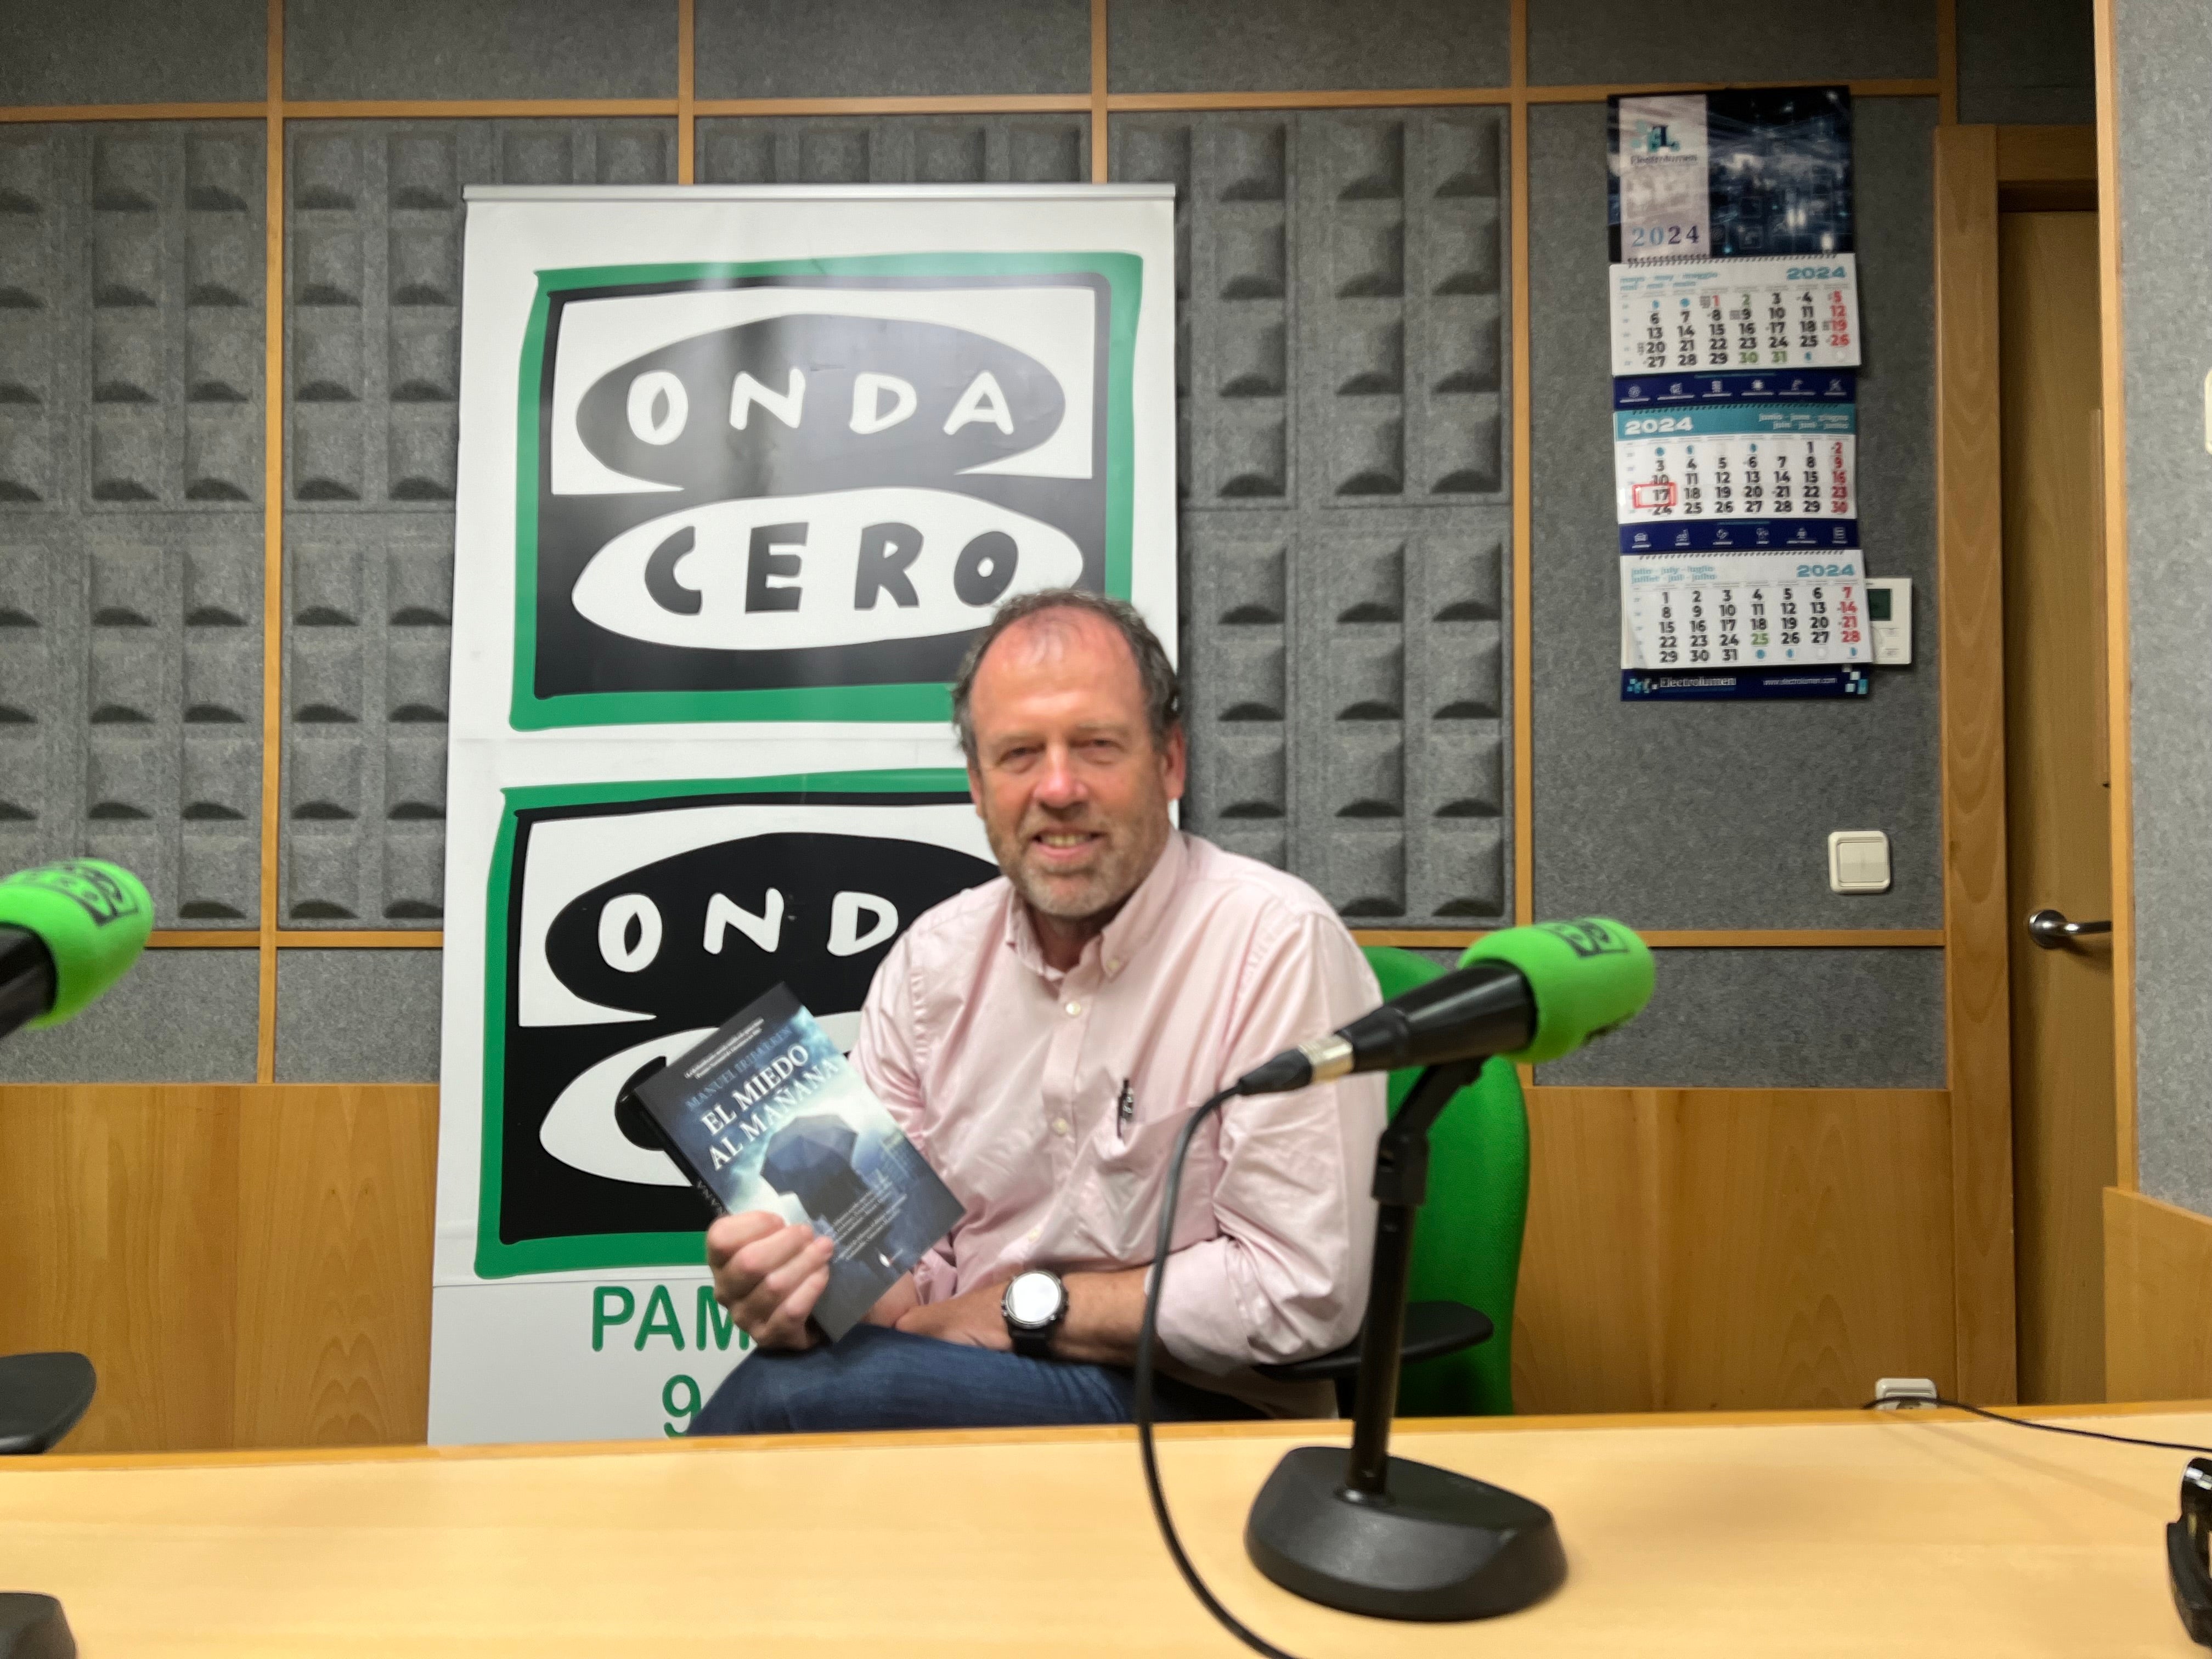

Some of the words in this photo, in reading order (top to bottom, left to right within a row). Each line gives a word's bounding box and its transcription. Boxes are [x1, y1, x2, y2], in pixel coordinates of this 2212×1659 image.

[1633, 225, 1699, 247] 2024
[1787, 267, 1846, 280] 2024
[1713, 295, 1720, 307] 1
[1742, 294, 1751, 305] 2
[1772, 292, 1781, 304] 3
[1803, 292, 1813, 302] 4
[1650, 312, 1660, 324] 6
[1681, 311, 1690, 323] 7
[1712, 309, 1722, 321] 8
[1742, 309, 1751, 320] 9
[1769, 307, 1786, 319] 10
[1802, 306, 1814, 318] 11
[1830, 305, 1846, 317] 12
[1647, 327, 1662, 338] 13
[1678, 325, 1695, 337] 14
[1709, 324, 1725, 335] 15
[1739, 323, 1755, 334] 16
[1769, 321, 1785, 334] 17
[1800, 320, 1816, 332] 18
[1832, 320, 1847, 331] 19
[1646, 341, 1665, 354] 20
[1679, 340, 1694, 352] 21
[1709, 338, 1727, 350] 22
[1739, 337, 1756, 349] 23
[1769, 336, 1788, 348] 24
[1800, 335, 1818, 347] 25
[1830, 334, 1850, 346] 26
[1647, 356, 1665, 368] 27
[1678, 354, 1697, 366] 28
[1709, 353, 1728, 365] 29
[1739, 352, 1758, 363] 30
[1771, 351, 1787, 363] 31
[627, 368, 1014, 445] ONDA
[1625, 417, 1694, 435] 2024
[1807, 441, 1814, 453] 1
[1835, 442, 1843, 454] 2
[1656, 460, 1664, 472] 3
[1687, 458, 1697, 469] 4
[1719, 457, 1727, 469] 5
[1748, 456, 1757, 469] 6
[1777, 456, 1786, 468] 7
[1807, 456, 1815, 469] 8
[1835, 456, 1843, 469] 9
[1652, 475, 1669, 484] 10
[1685, 473, 1698, 484] 11
[1716, 472, 1730, 483] 12
[1746, 471, 1759, 483] 13
[1774, 471, 1791, 483] 14
[1803, 471, 1818, 483] 15
[1832, 471, 1846, 484] 16
[1654, 489, 1669, 501] 17
[1684, 488, 1700, 499] 18
[1715, 487, 1731, 498] 19
[1744, 486, 1762, 498] 20
[1775, 486, 1790, 498] 21
[1803, 486, 1820, 498] 22
[1832, 486, 1847, 498] 23
[1652, 505, 1672, 516] 24
[1684, 502, 1702, 514] 25
[1714, 501, 1733, 513] 26
[1745, 500, 1763, 512] 27
[1774, 500, 1792, 512] 28
[1803, 500, 1820, 512] 29
[1831, 501, 1848, 514] 30
[645, 522, 1019, 616] CERO
[1797, 564, 1855, 577] 2024
[1662, 592, 1668, 603] 1
[1692, 590, 1701, 602] 2
[1722, 590, 1731, 602] 3
[1752, 588, 1763, 600] 4
[1784, 588, 1792, 600] 5
[1813, 587, 1822, 599] 6
[1842, 586, 1852, 598] 7
[1662, 607, 1671, 619] 8
[1692, 605, 1702, 617] 9
[1719, 605, 1736, 617] 10
[1751, 603, 1764, 615] 11
[1780, 602, 1796, 614] 12
[1809, 602, 1826, 614] 13
[1840, 601, 1858, 613] 14
[1659, 621, 1675, 634] 15
[1689, 620, 1706, 633] 16
[1720, 619, 1736, 631] 17
[1750, 618, 1767, 630] 18
[1781, 617, 1797, 629] 19
[1809, 617, 1829, 629] 20
[1842, 616, 1857, 628] 21
[1659, 636, 1677, 648] 22
[1690, 635, 1708, 647] 23
[1719, 634, 1739, 646] 24
[1751, 633, 1769, 645] 25
[1781, 632, 1799, 645] 26
[1811, 631, 1829, 644] 27
[1841, 630, 1861, 643] 28
[1659, 651, 1678, 663] 29
[1690, 650, 1709, 662] 30
[1722, 648, 1737, 661] 31
[599, 888, 900, 973] OND
[701, 1102, 737, 1136] EL
[732, 1043, 809, 1112] MIEDO
[709, 1136, 743, 1171] AL
[740, 1059, 839, 1143] MAÑANA
[592, 1284, 750, 1352] PAM
[662, 1374, 702, 1439] 9
